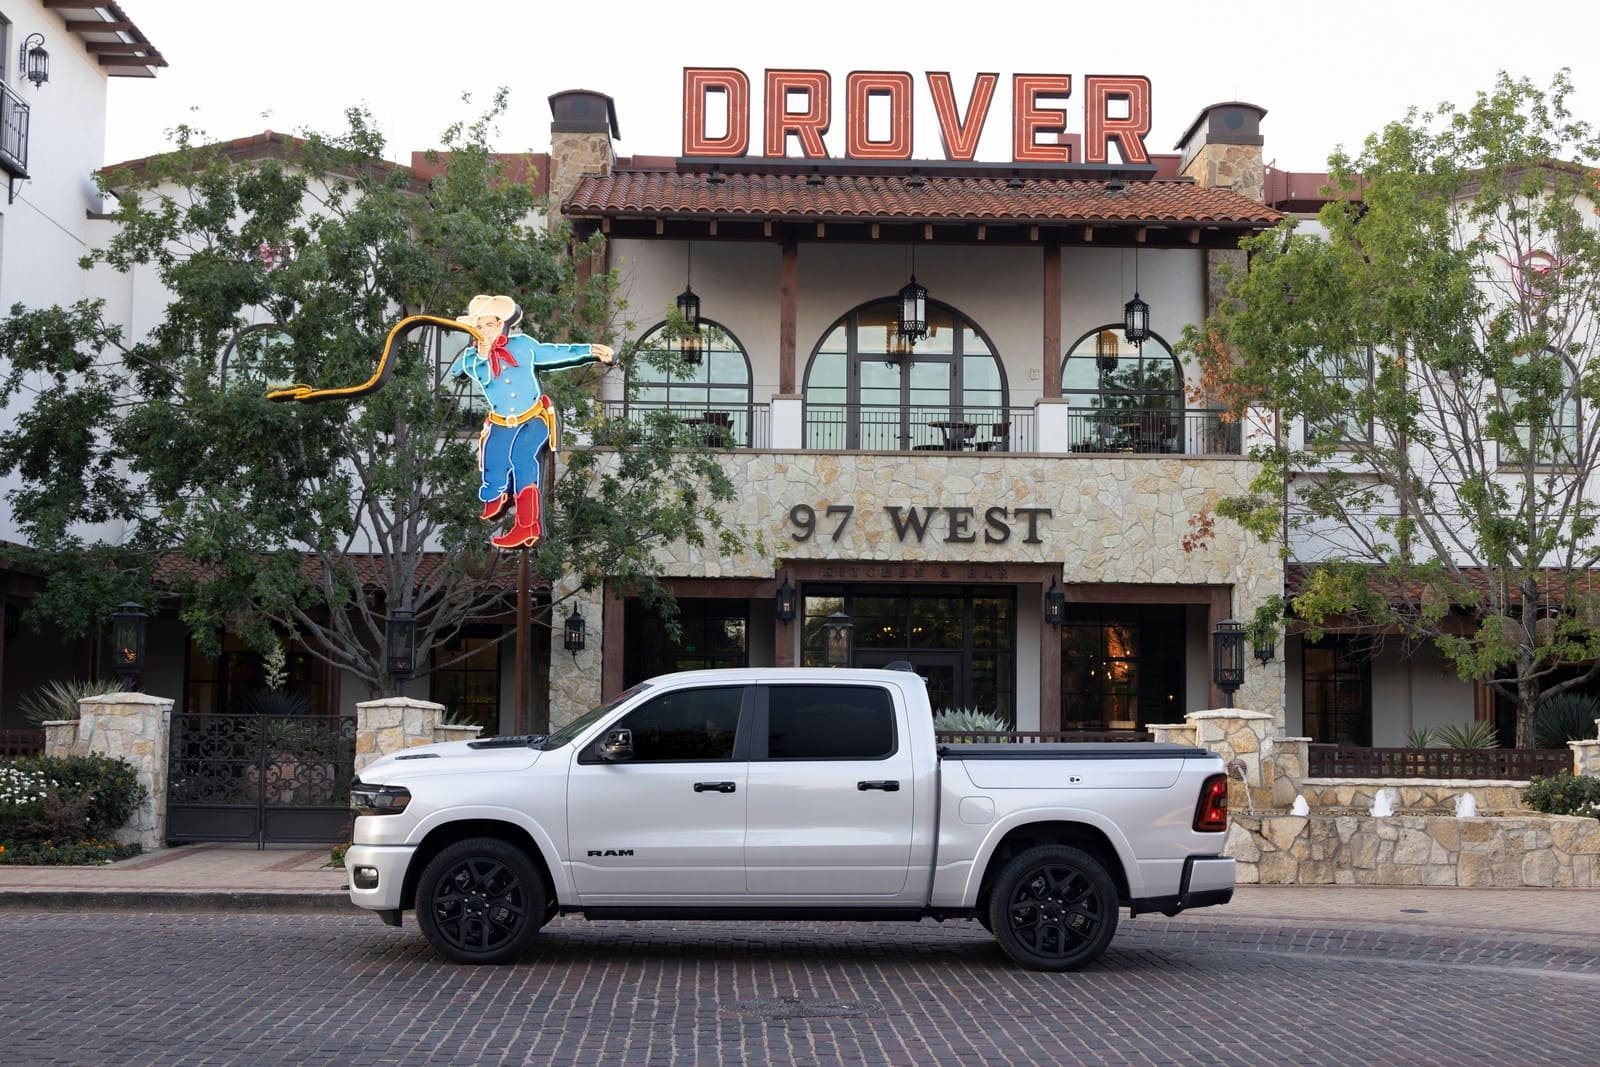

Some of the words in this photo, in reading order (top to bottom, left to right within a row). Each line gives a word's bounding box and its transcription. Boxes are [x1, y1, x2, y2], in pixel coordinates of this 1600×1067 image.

[683, 67, 1152, 164] DROVER
[789, 503, 854, 542] 97
[883, 505, 1053, 545] WEST
[821, 566, 925, 578] KITCHEN
[587, 849, 634, 857] RAM
